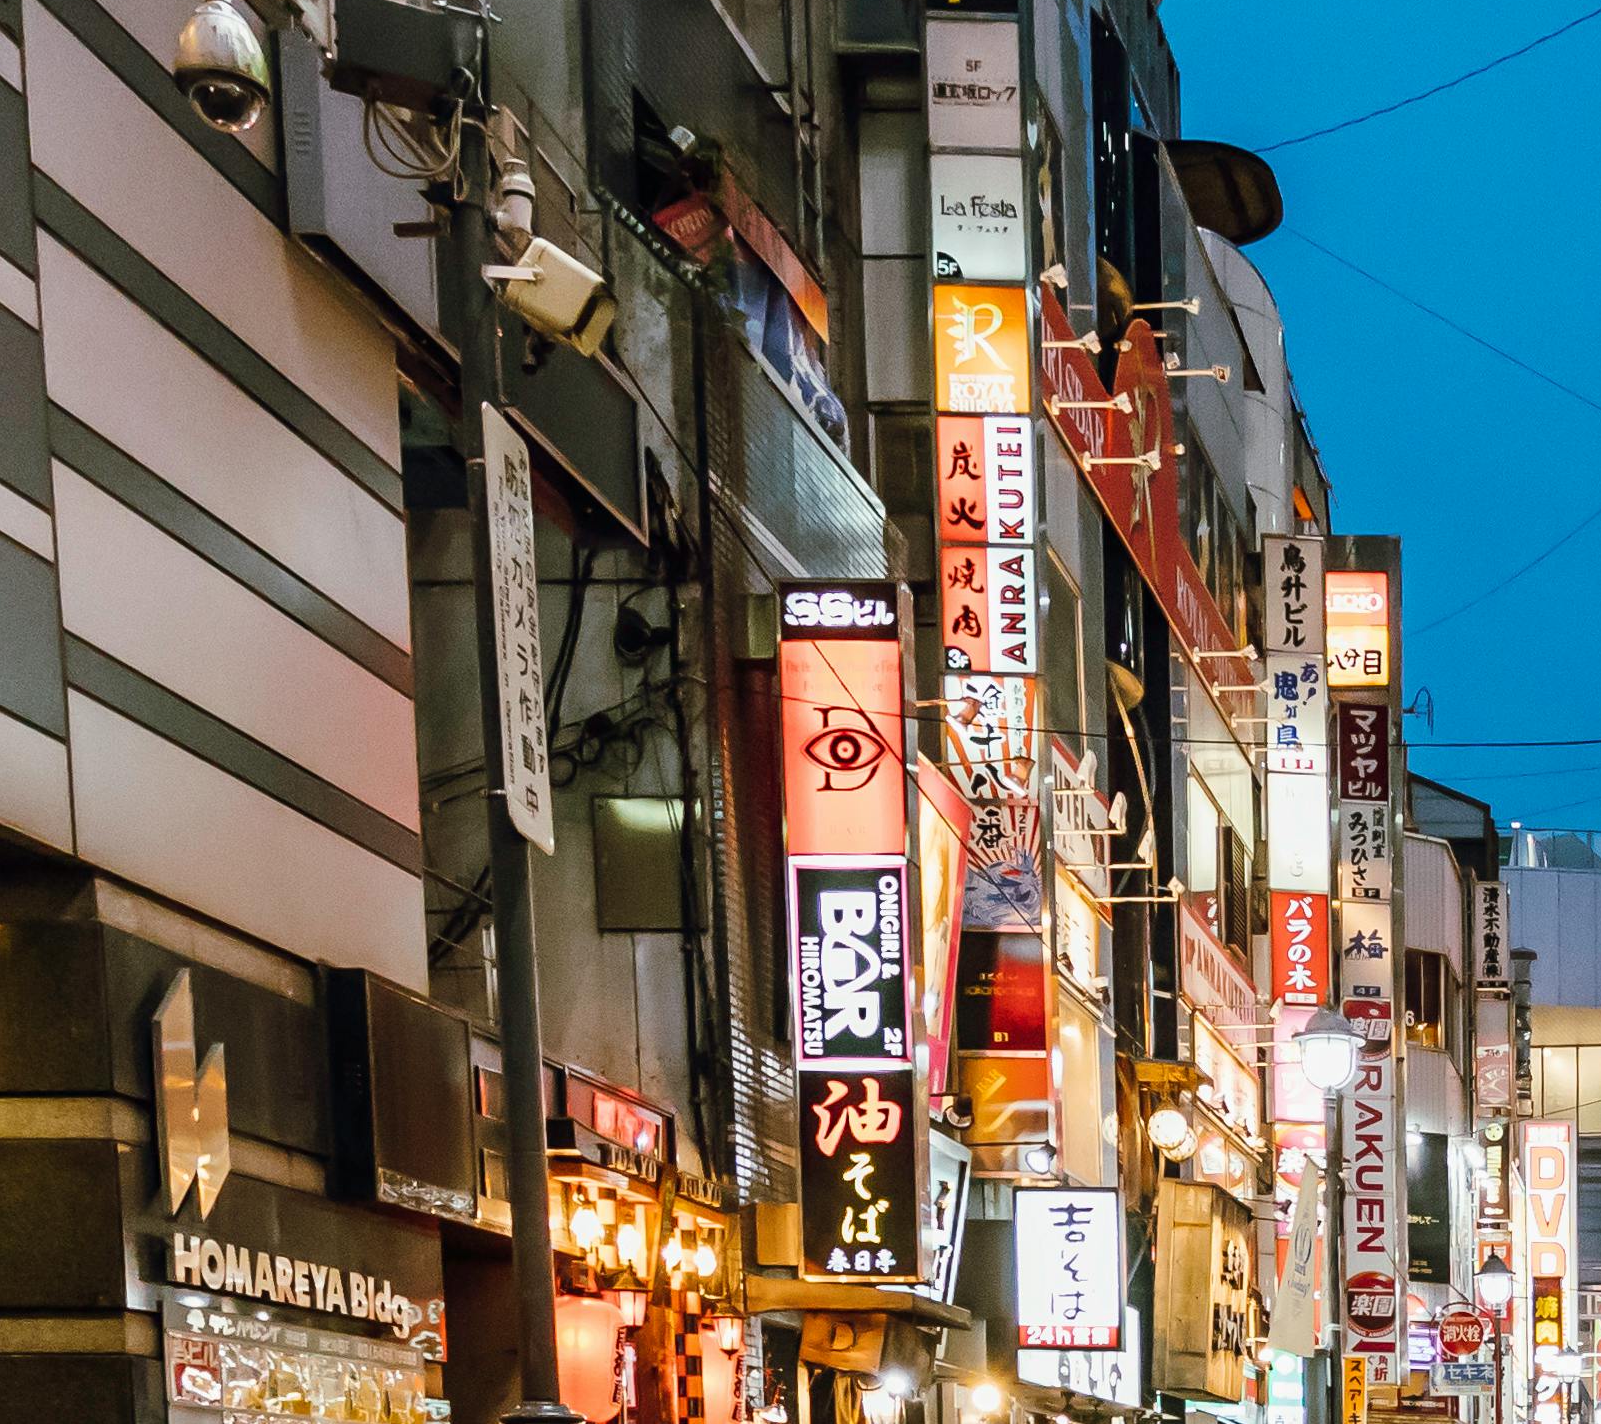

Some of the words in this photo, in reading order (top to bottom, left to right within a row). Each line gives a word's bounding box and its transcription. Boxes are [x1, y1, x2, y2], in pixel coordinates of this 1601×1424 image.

[878, 875, 900, 958] ONIGIRI
[1284, 896, 1317, 991] バラの木
[799, 935, 825, 1057] HIROMATSU
[882, 1027, 902, 1057] 2F
[812, 1077, 903, 1245] 油そば
[1353, 1064, 1386, 1253] RAKUEN
[825, 1248, 897, 1274] 春日亭
[1529, 1145, 1566, 1277] DVD
[173, 1232, 349, 1316] HOMAREYA
[349, 1271, 411, 1339] Bldg
[1442, 1325, 1482, 1343] 消火栓
